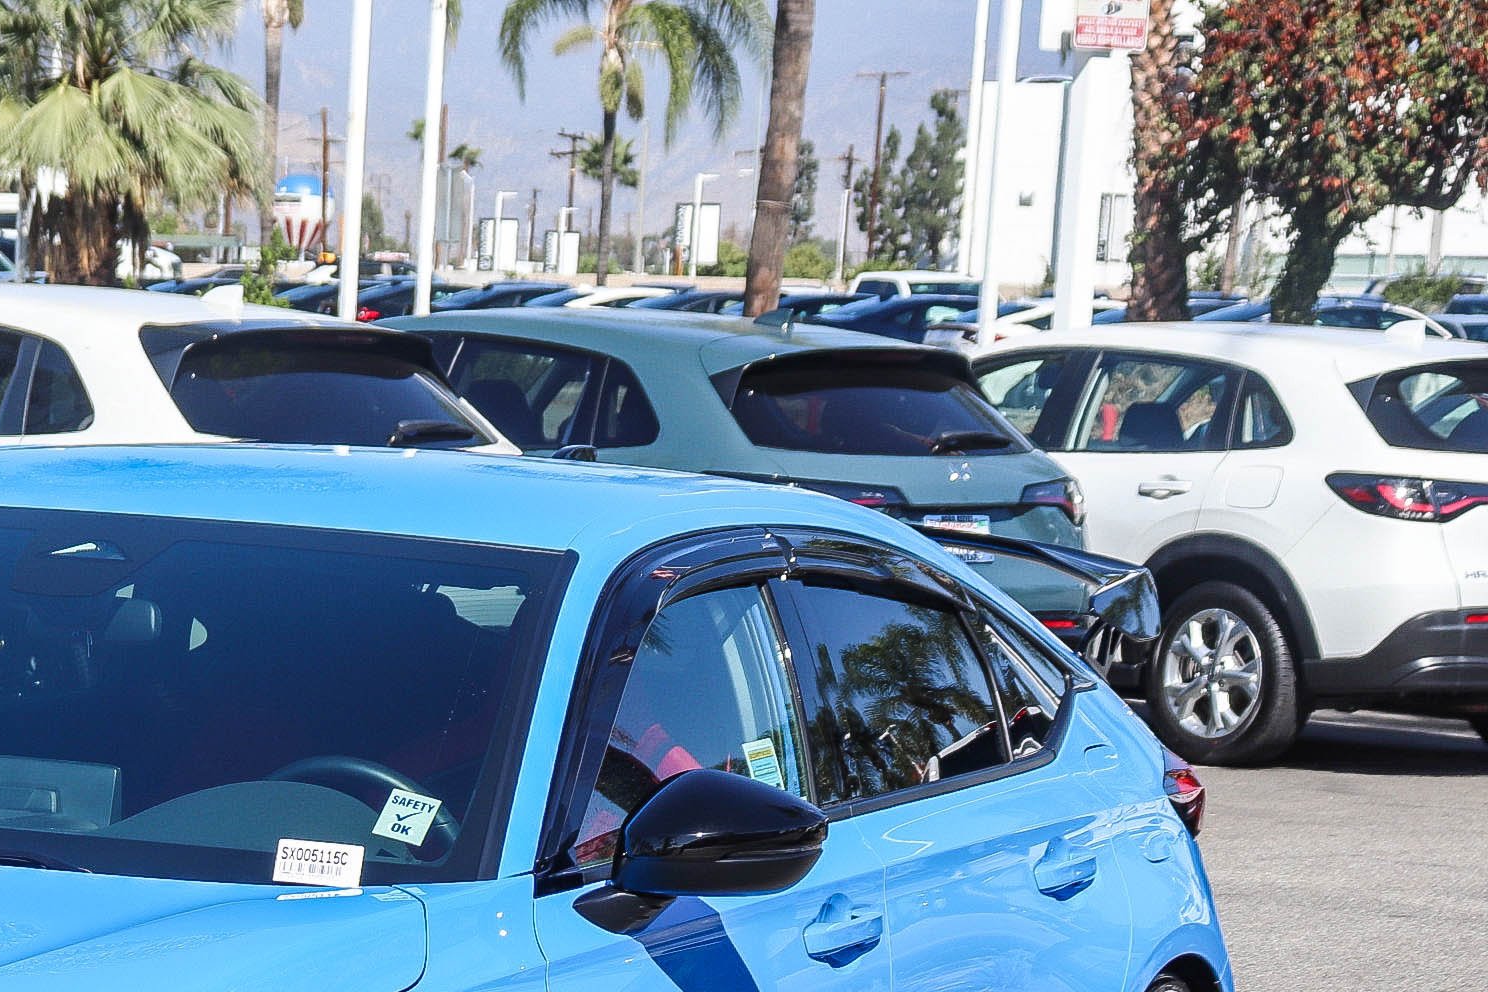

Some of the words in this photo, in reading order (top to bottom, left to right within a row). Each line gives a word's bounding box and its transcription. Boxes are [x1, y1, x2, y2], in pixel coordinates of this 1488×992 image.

[390, 795, 435, 814] SAFETY
[390, 822, 412, 836] OK
[281, 846, 349, 866] SX005115C
